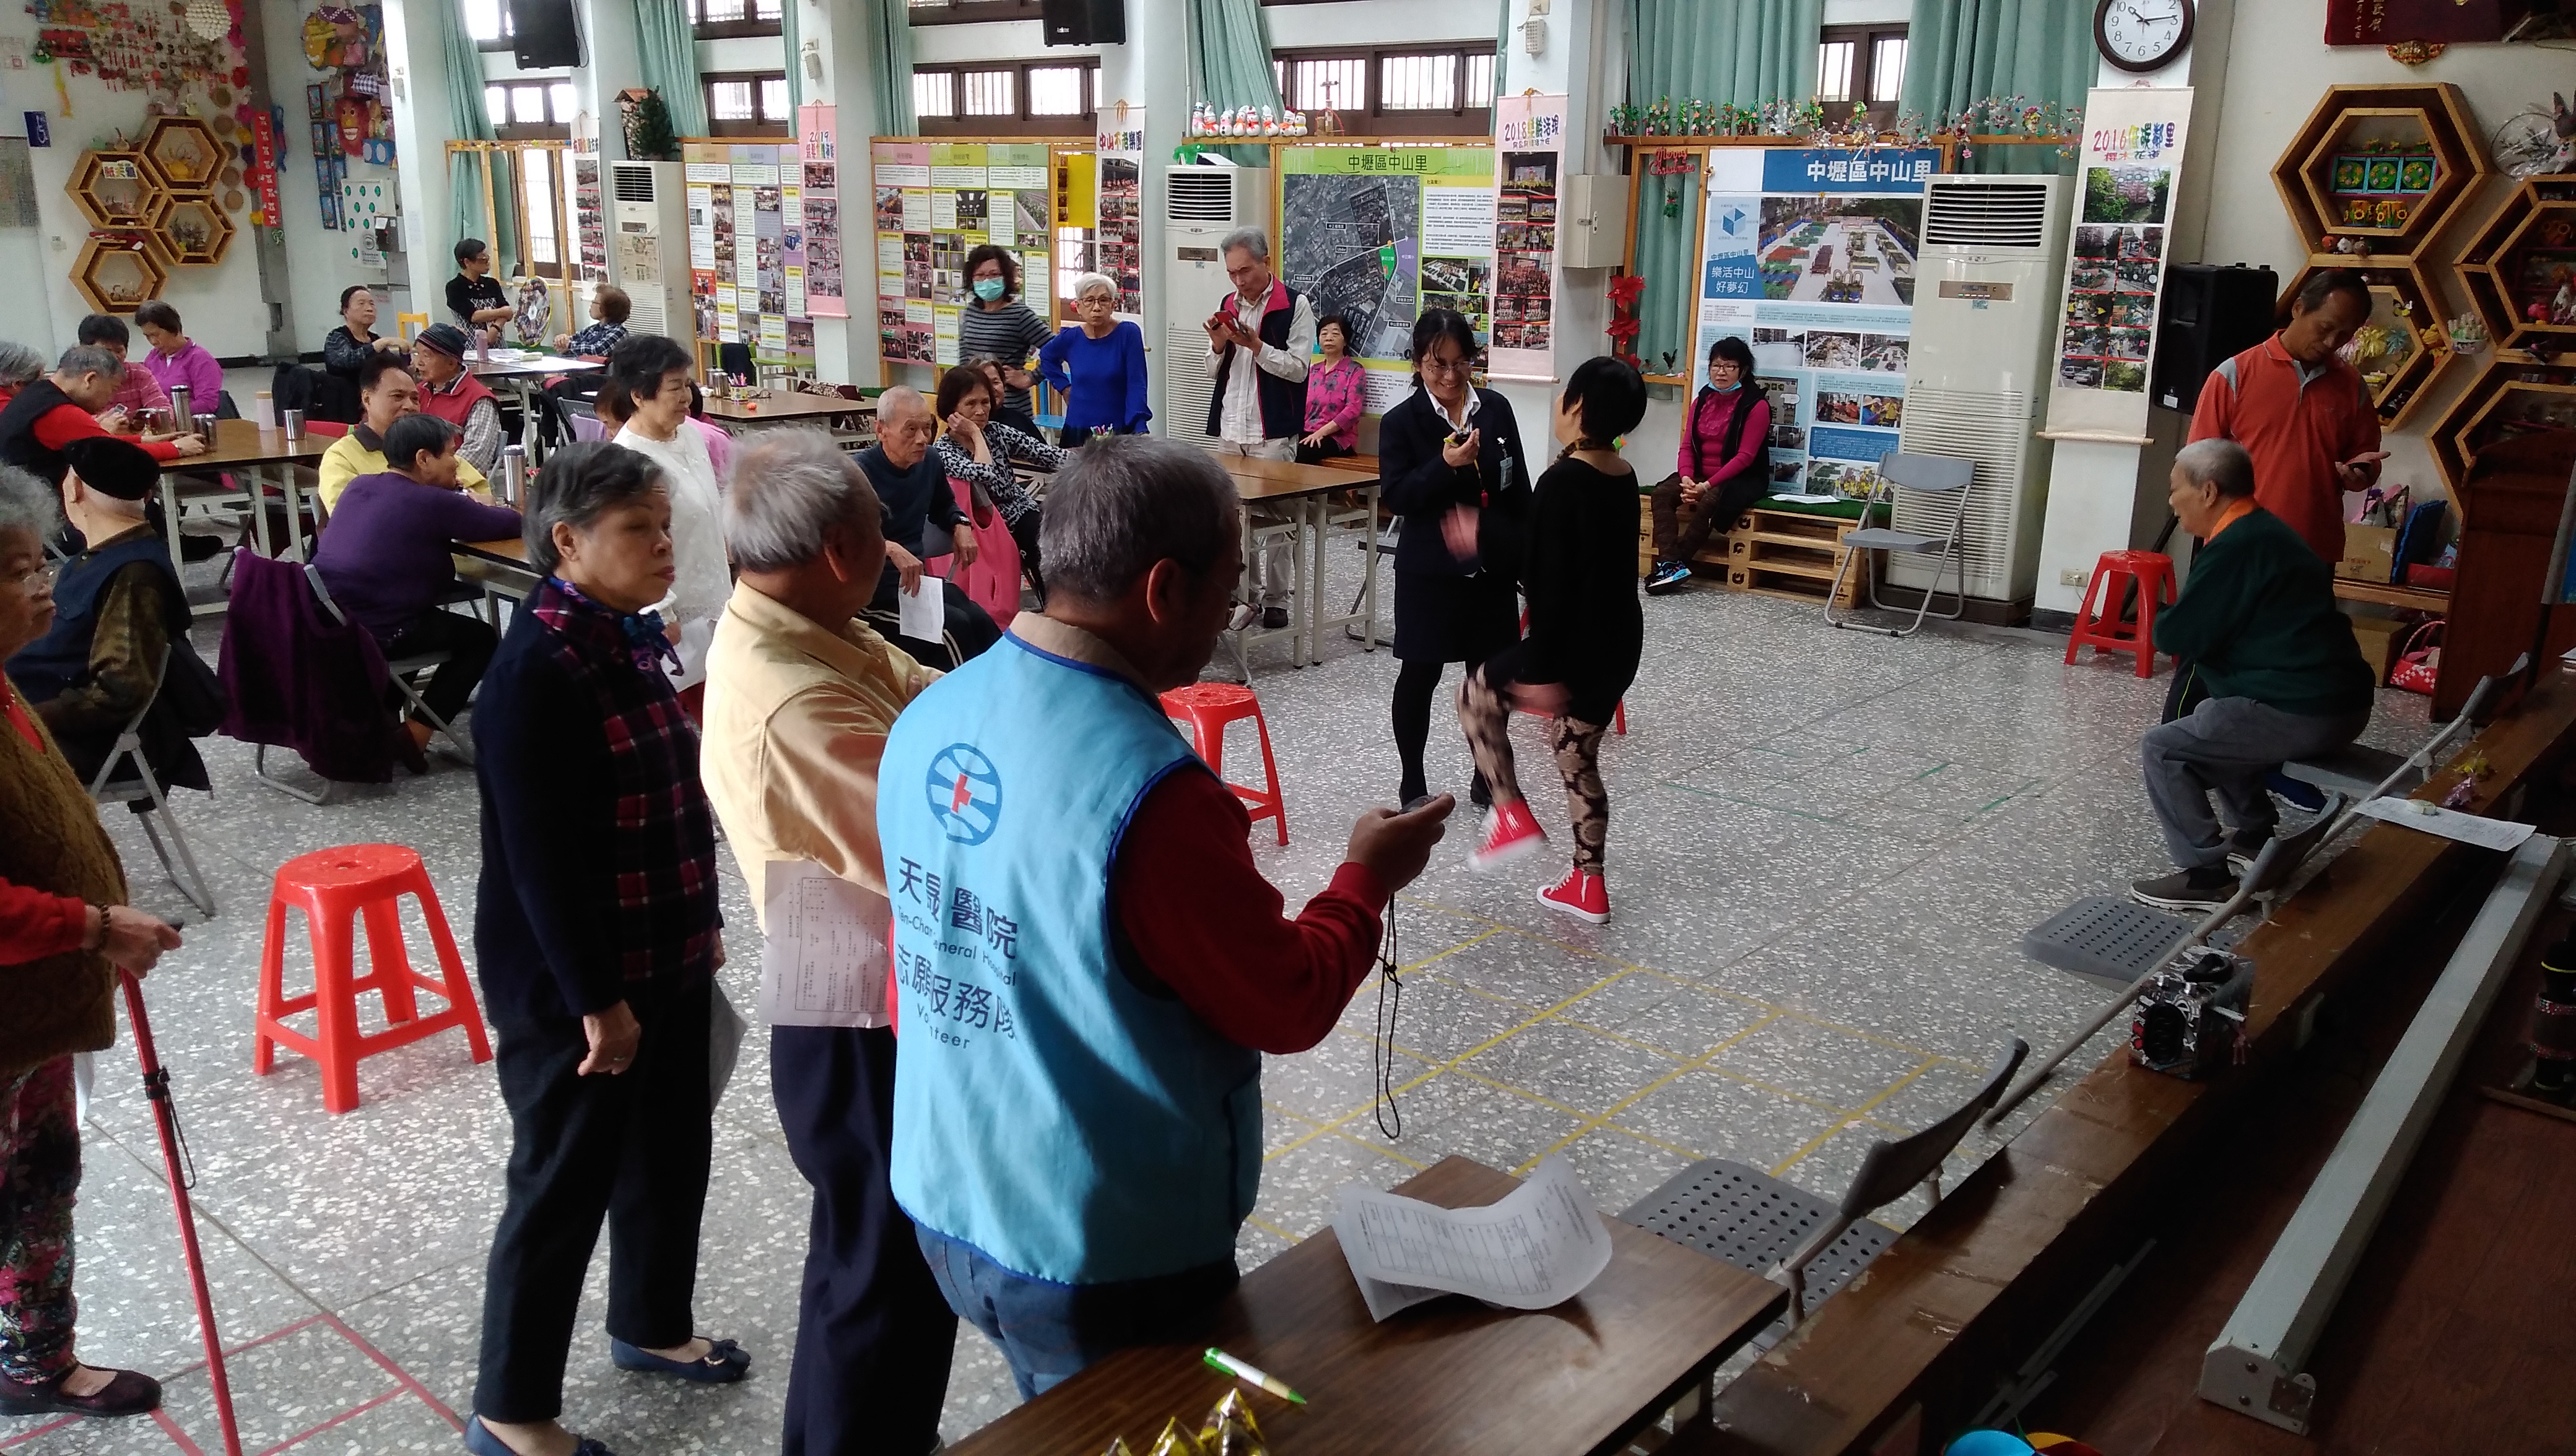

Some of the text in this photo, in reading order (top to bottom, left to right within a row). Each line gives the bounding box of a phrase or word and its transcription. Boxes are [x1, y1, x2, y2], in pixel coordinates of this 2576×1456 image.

[2117, 2, 2126, 12] 10
[2169, 0, 2177, 9] 2
[2112, 16, 2119, 27] 9
[2170, 15, 2178, 25] 3
[2114, 31, 2122, 41] 8
[2164, 30, 2171, 41] 4
[2125, 42, 2133, 53] 7
[2138, 46, 2146, 56] 6
[2153, 42, 2160, 52] 5
[1655, 146, 1688, 163] Merry
[1348, 154, 1427, 171] 中壢區中山里
[1648, 160, 1695, 176] Christmas
[1808, 160, 1931, 182] 中壢區中山里
[1711, 266, 1755, 279] 樂活中山
[1715, 280, 1749, 294] 好夢幻
[933, 940, 977, 960] eneral
